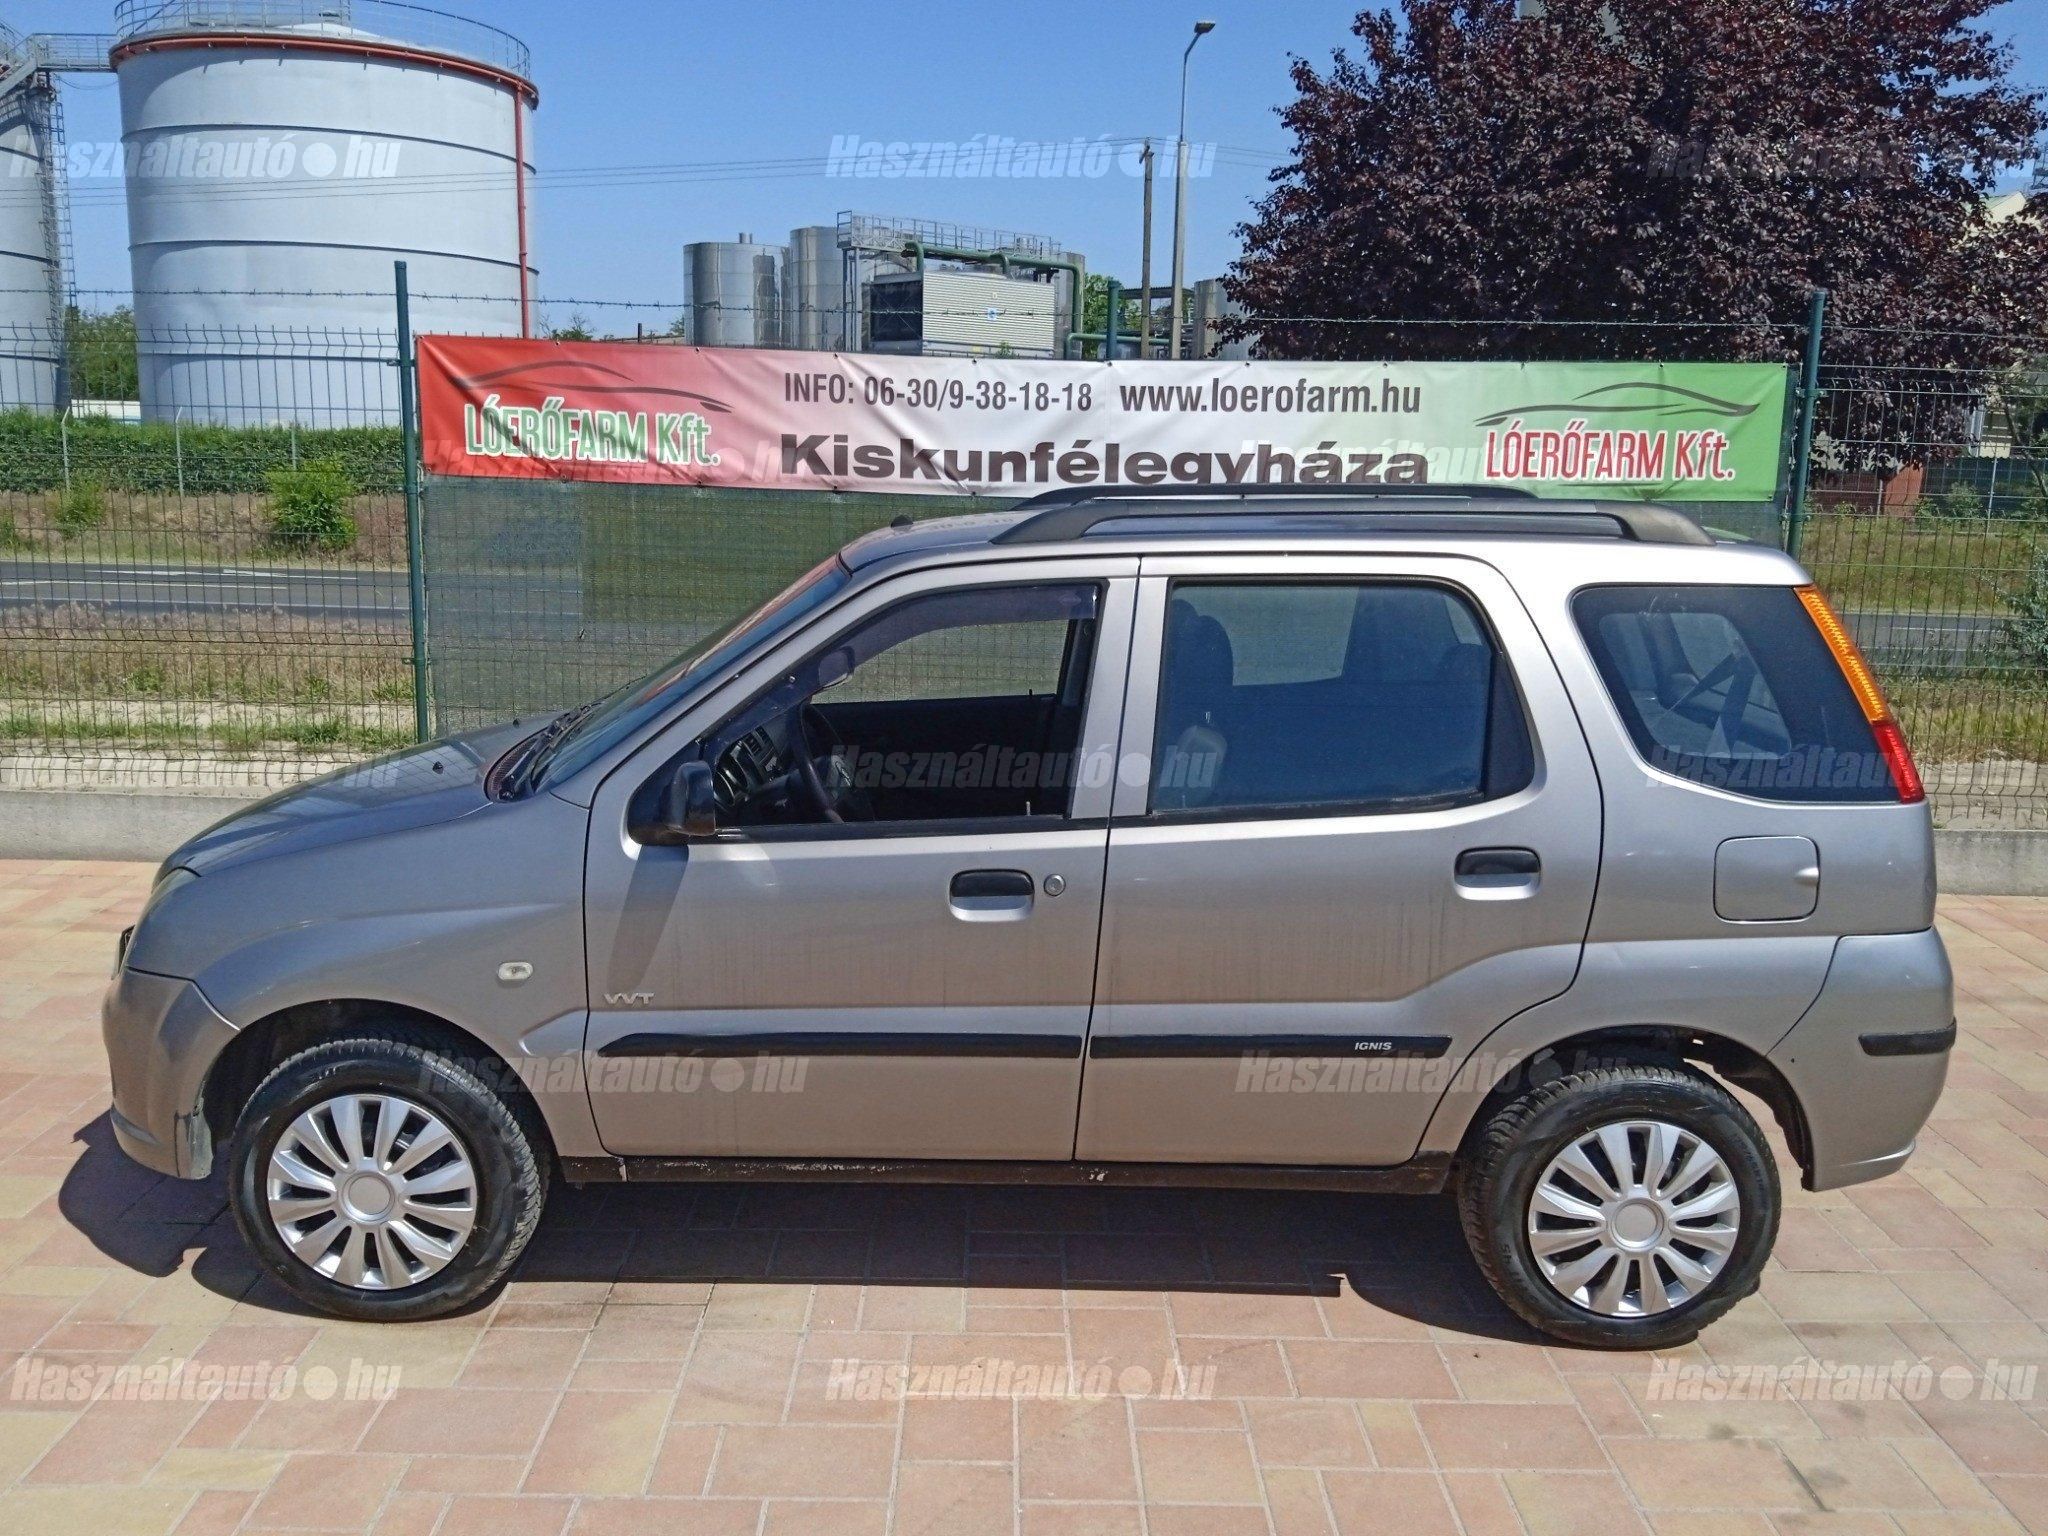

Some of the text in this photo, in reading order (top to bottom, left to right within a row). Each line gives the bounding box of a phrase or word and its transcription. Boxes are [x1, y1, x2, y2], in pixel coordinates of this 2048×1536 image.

[784, 372, 1422, 413] INFO: 06-30/9-38-18-18 www.loerofarm.hu
[464, 394, 650, 463] LÓERŐFARM
[656, 411, 722, 466] Kft.
[1484, 419, 1668, 480] LÓERŐFARM
[1673, 429, 1736, 480] Kft.
[780, 432, 1430, 485] Kiskunfélegyháza
[1354, 1041, 1393, 1051] IGNIS
